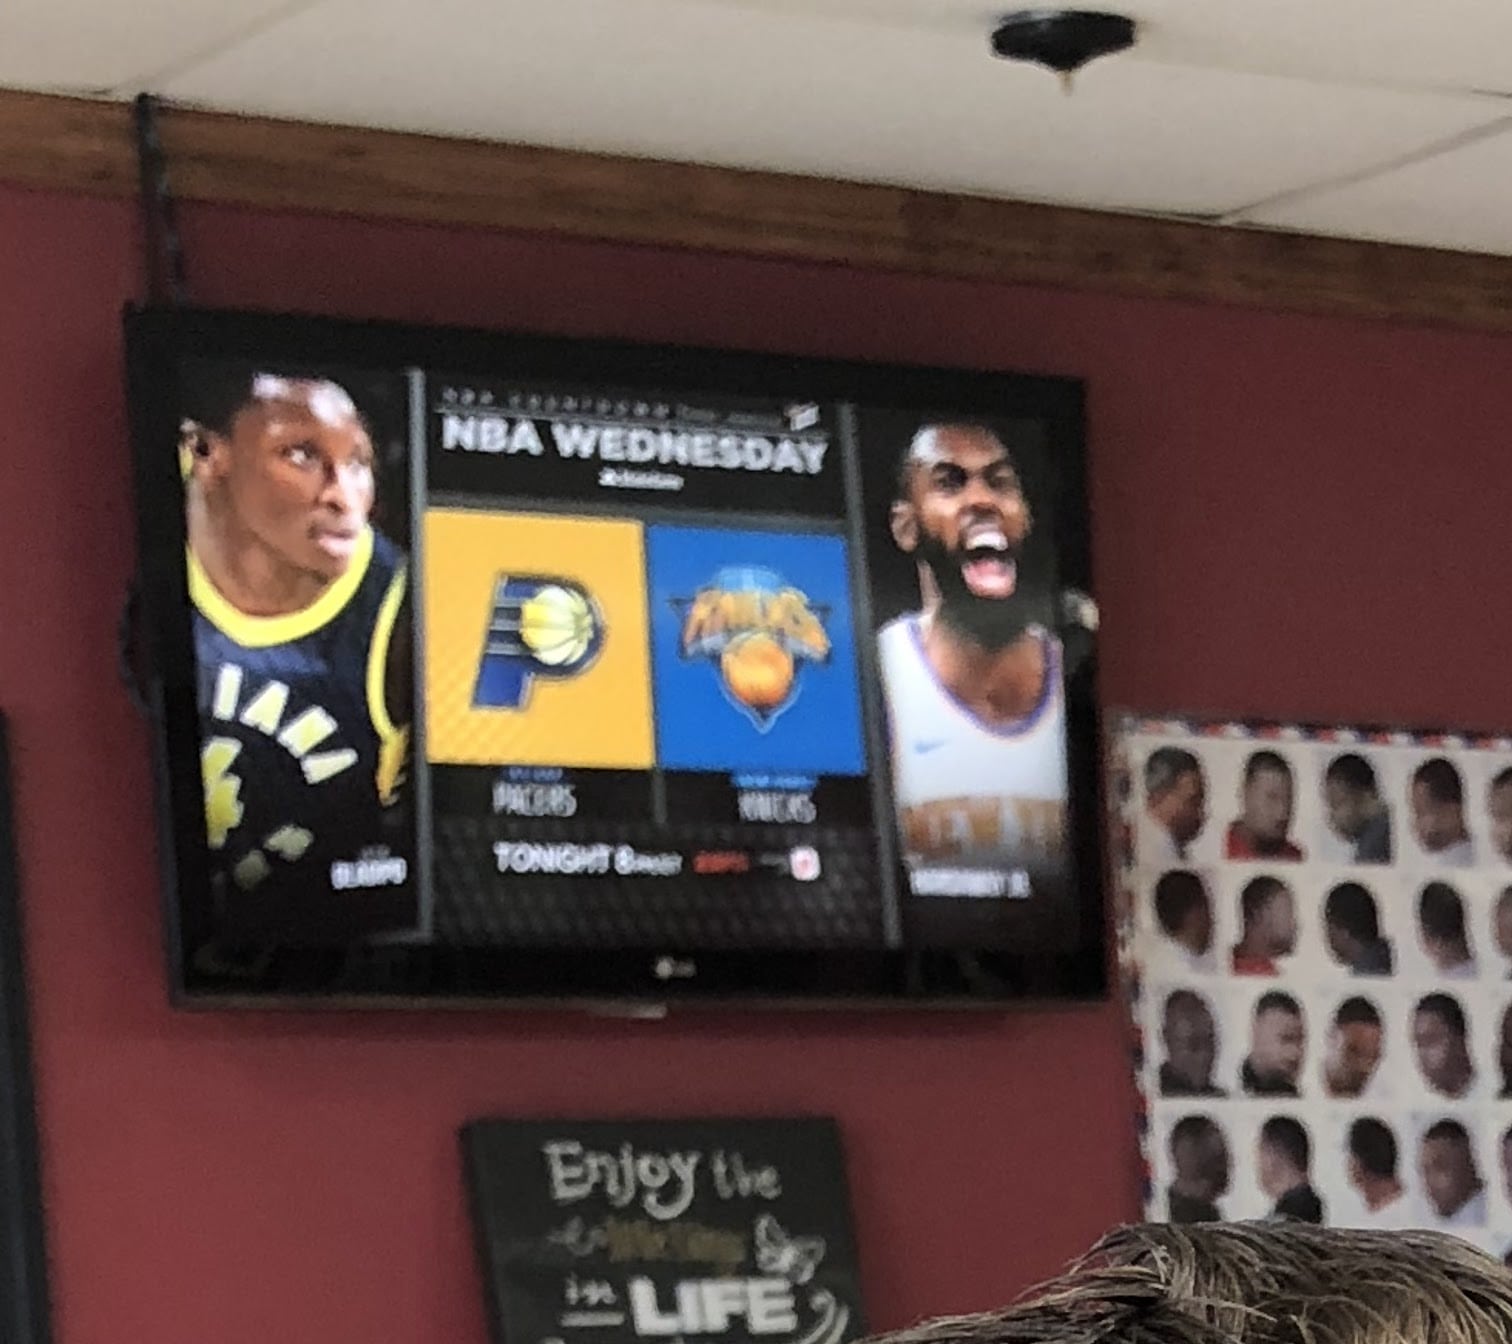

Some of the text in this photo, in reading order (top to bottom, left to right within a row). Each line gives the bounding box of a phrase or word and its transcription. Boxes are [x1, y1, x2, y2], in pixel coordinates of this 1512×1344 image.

[441, 414, 829, 475] NBA WEDNESDAY
[543, 1139, 699, 1220] Enjoy
[627, 1274, 799, 1337] LIFE
